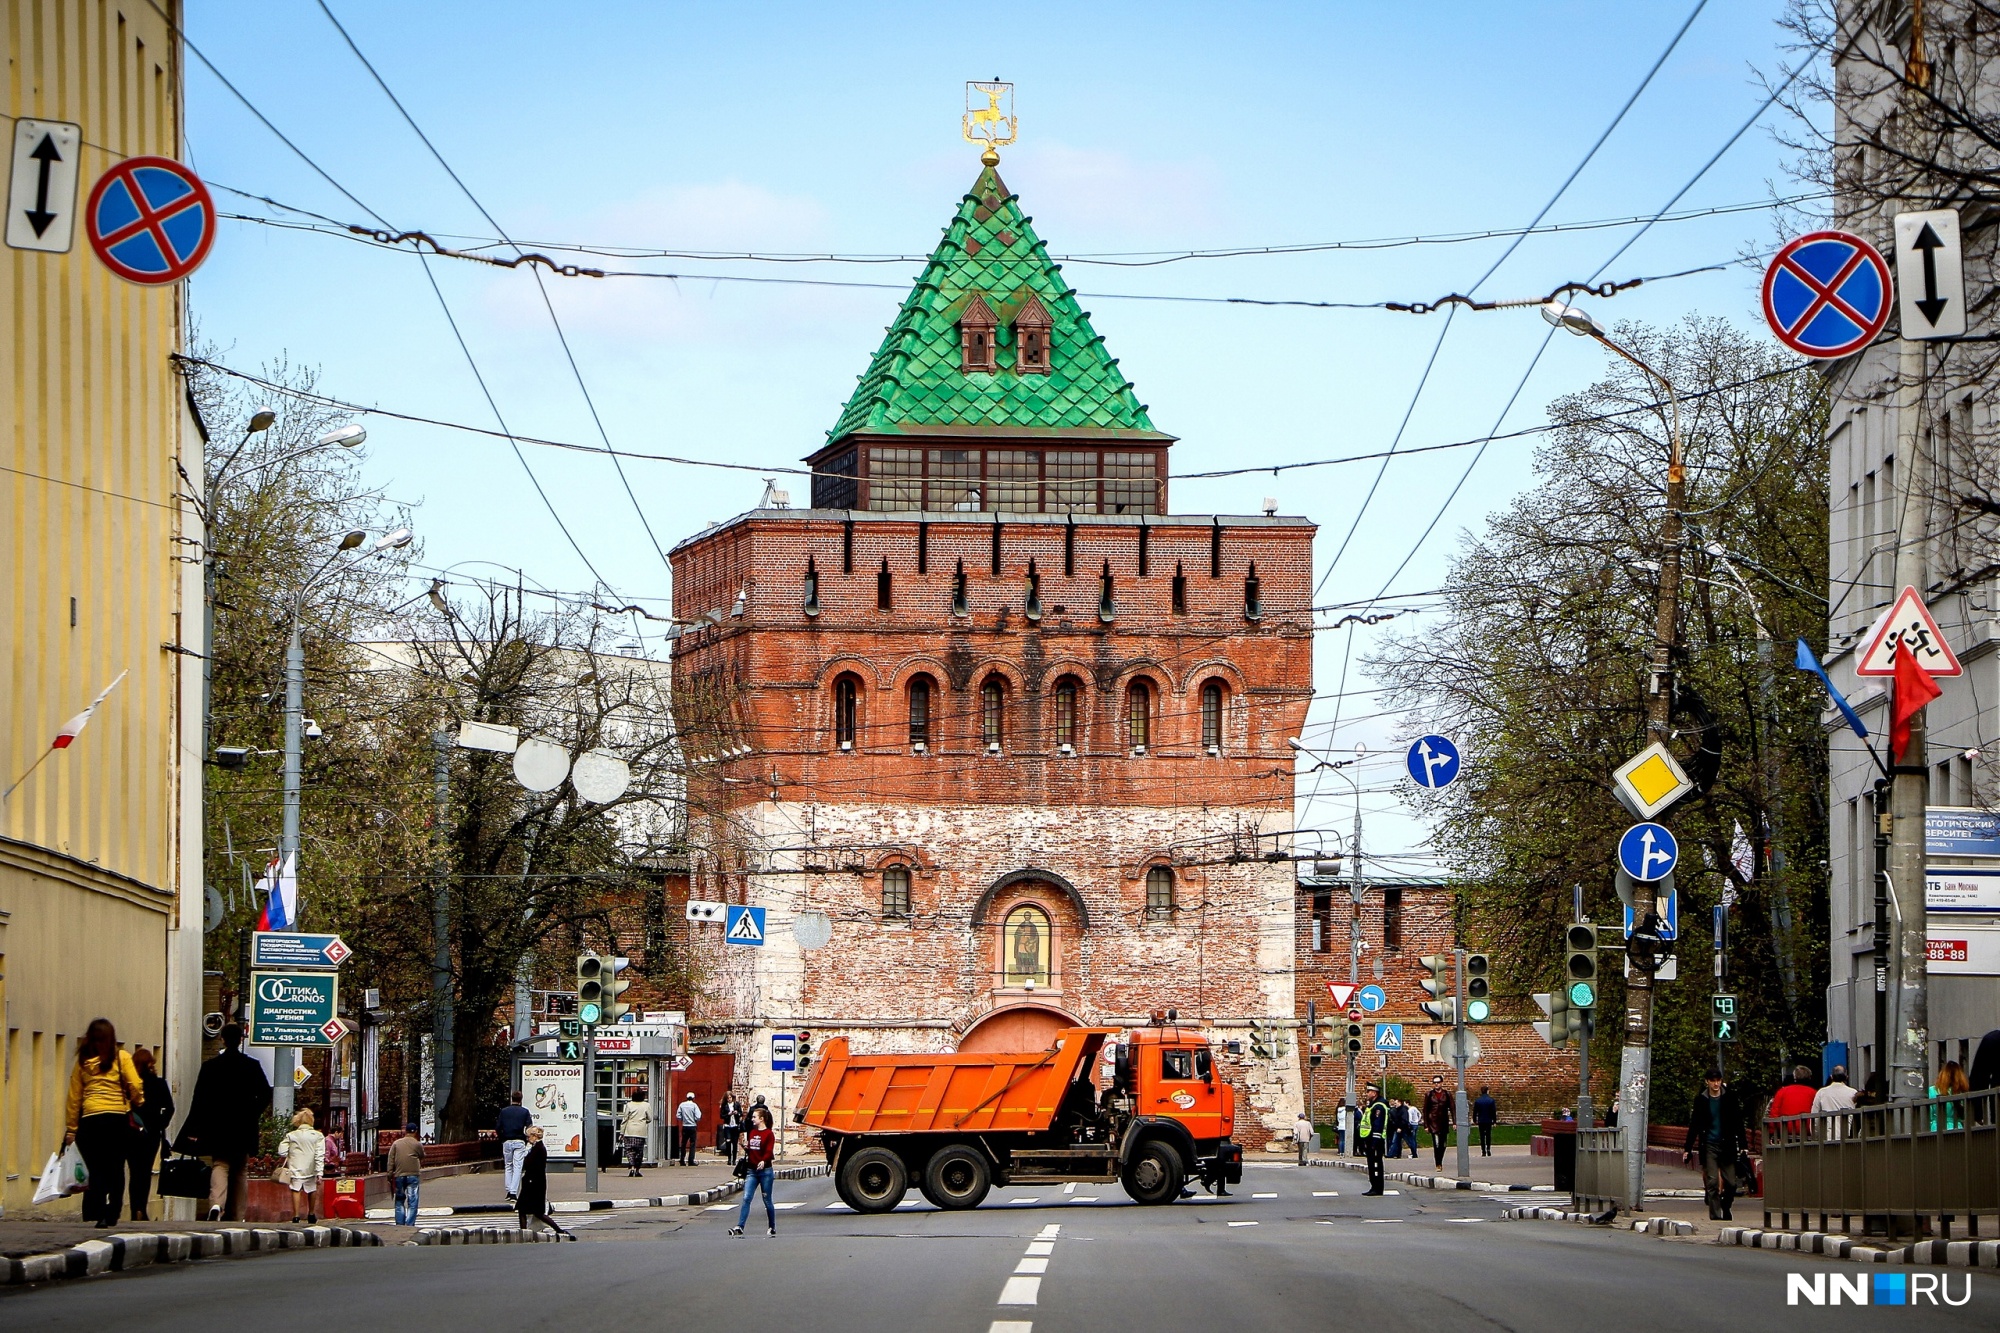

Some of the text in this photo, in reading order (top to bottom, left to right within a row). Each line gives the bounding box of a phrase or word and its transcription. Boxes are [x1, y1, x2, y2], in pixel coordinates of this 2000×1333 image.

[1926, 881, 1941, 891] ТБ
[1716, 998, 1734, 1014] 43
[563, 1020, 580, 1036] 43
[278, 1034, 316, 1042] 439-13-40
[533, 1068, 581, 1077] ЗОЛОТОЙ
